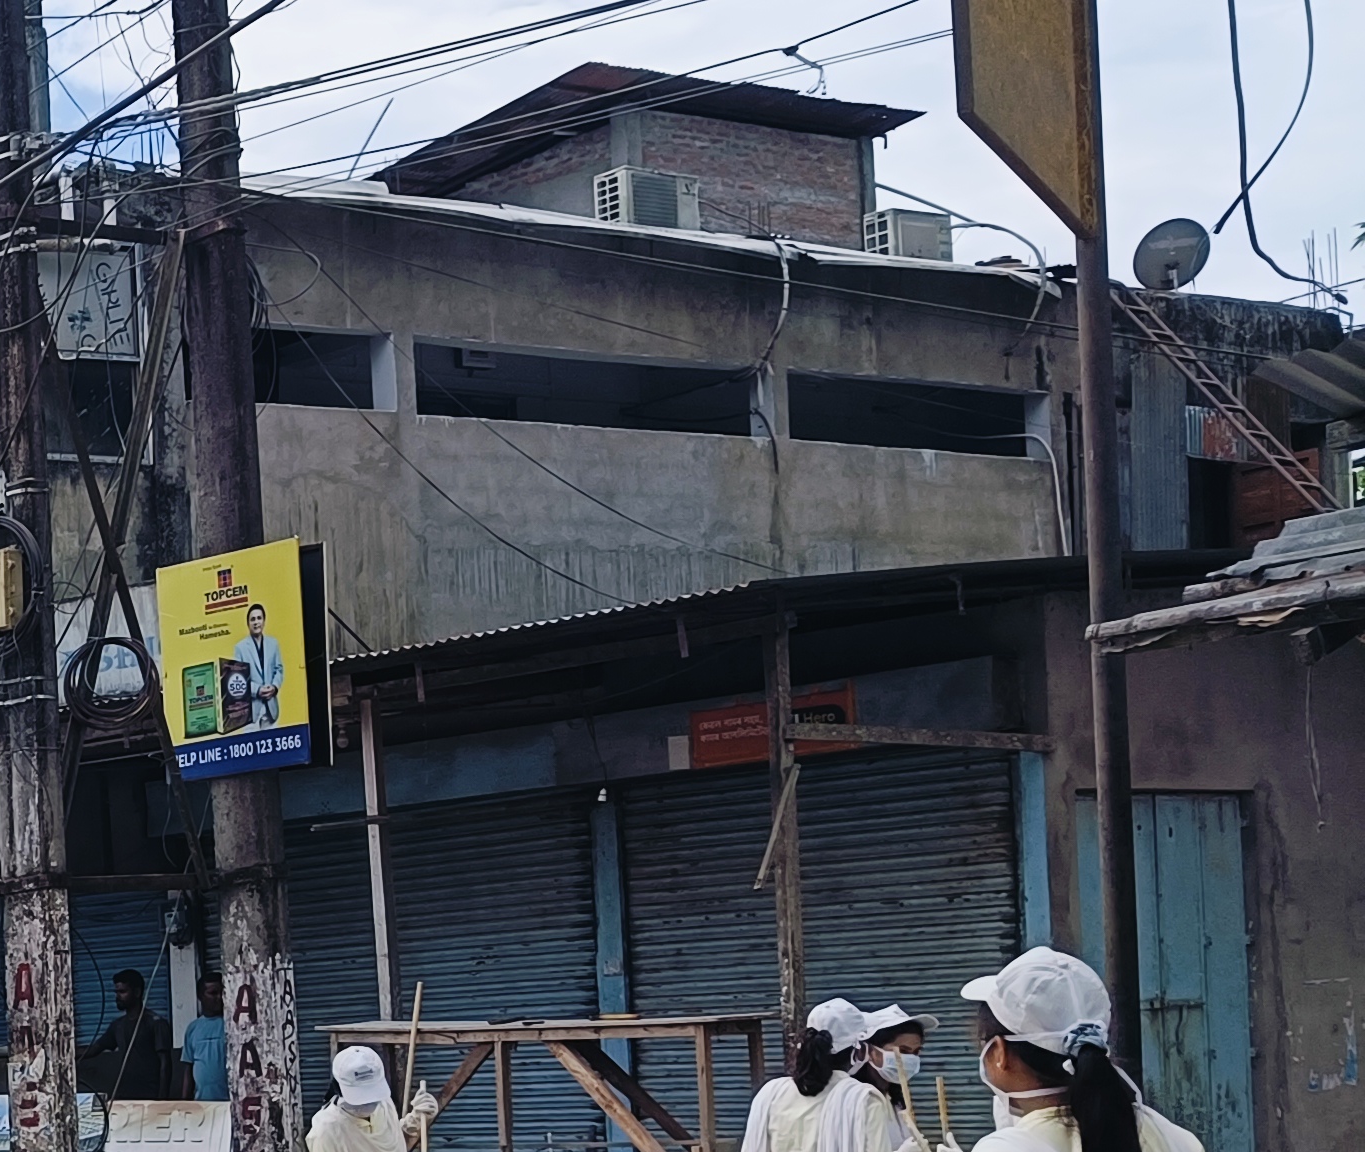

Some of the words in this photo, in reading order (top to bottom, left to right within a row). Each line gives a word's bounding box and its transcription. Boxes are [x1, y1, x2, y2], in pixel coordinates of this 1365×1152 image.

[204, 584, 248, 602] TOPCEM
[229, 682, 247, 692] SDC
[803, 711, 836, 724] Hero
[198, 747, 222, 765] LINE
[229, 742, 254, 759] 1800
[255, 738, 273, 755] 123
[275, 734, 302, 752] 3666
